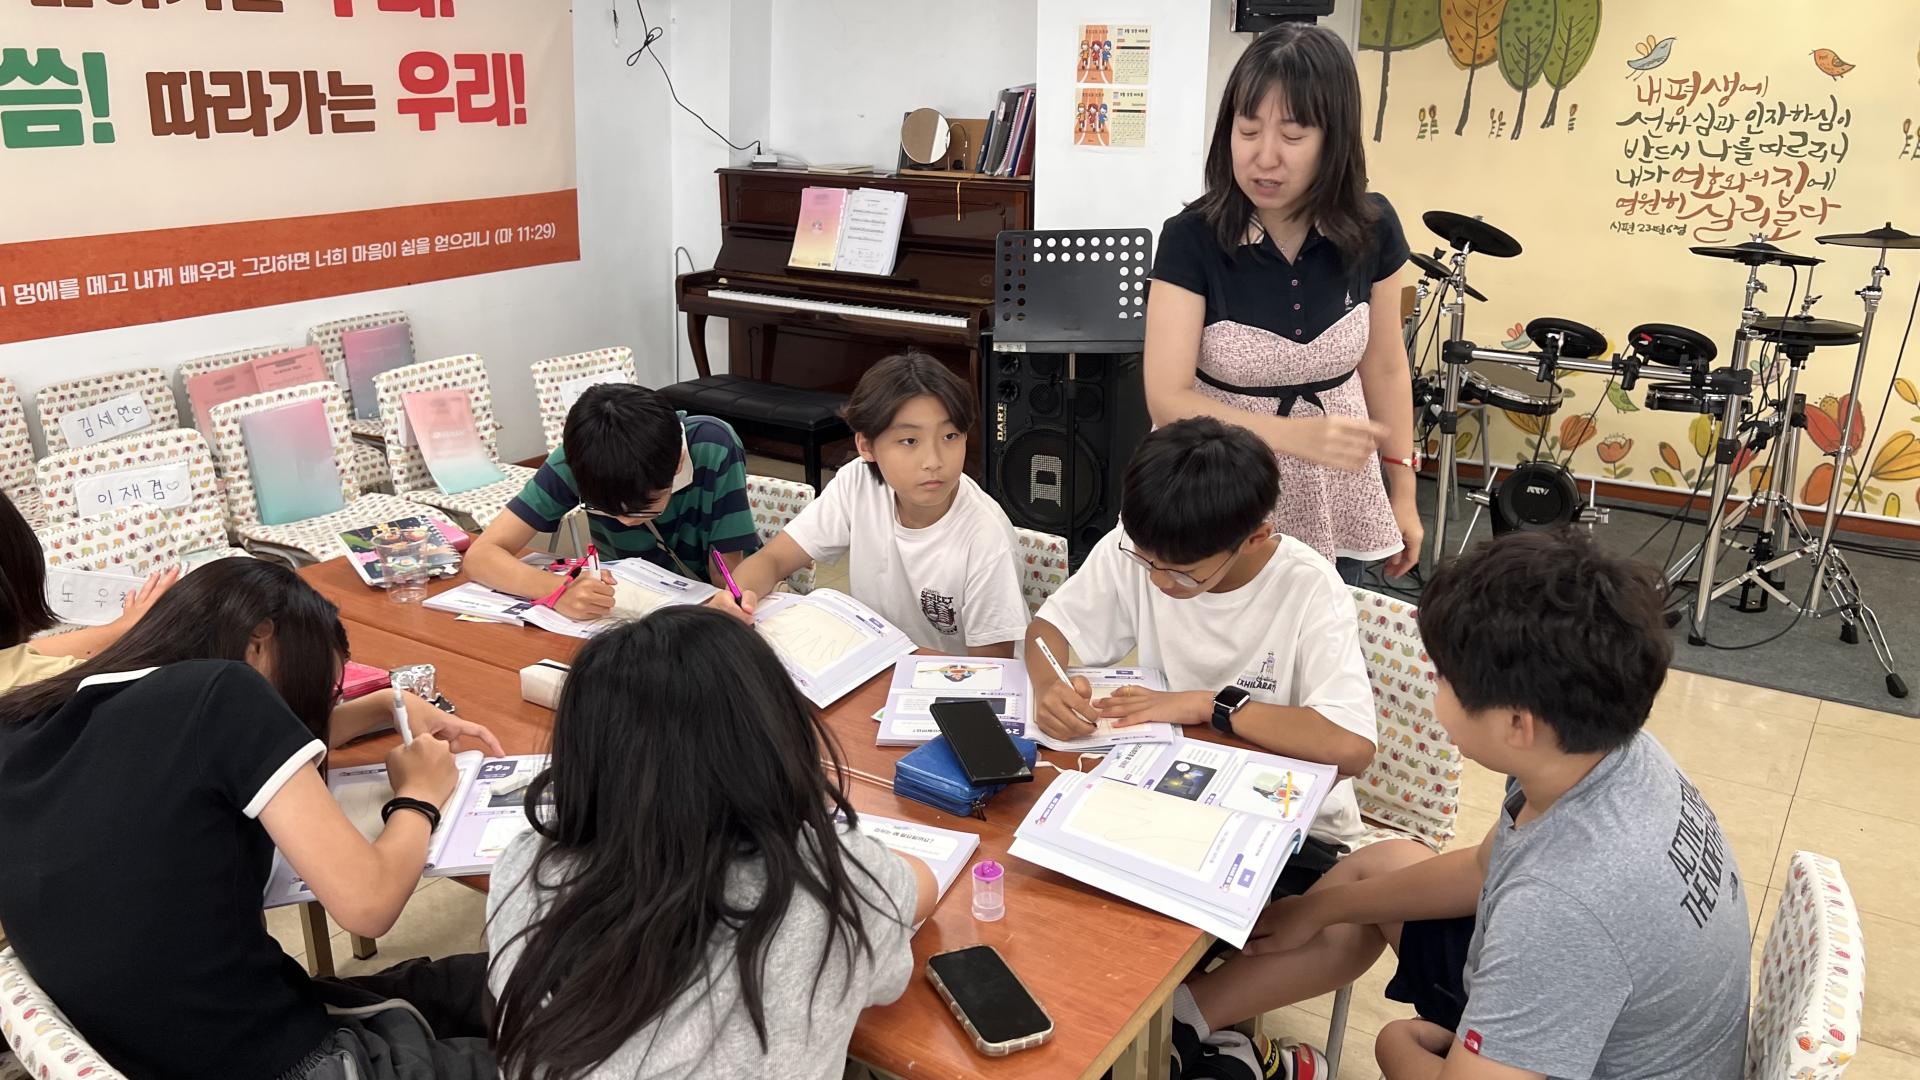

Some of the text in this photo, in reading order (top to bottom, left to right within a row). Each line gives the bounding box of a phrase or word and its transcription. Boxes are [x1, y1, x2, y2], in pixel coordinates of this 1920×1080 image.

[145, 70, 377, 139] 따라가는
[397, 51, 528, 131] 우리!
[1616, 95, 1851, 138] 선하심과 인자하심이
[1625, 131, 1849, 165] 반드시 나를 따르리니
[1616, 165, 1670, 188] 내가
[1672, 163, 1769, 199] 여호와의
[1610, 221, 1635, 235] 시편
[1616, 189, 1842, 243] 영원히 살리로다
[13, 278, 80, 305] 멍에를
[86, 272, 128, 296] 메고
[134, 268, 174, 290] 내게
[179, 260, 236, 284] 배우라
[241, 252, 310, 277] 그리하면
[315, 247, 347, 268] 너희
[352, 241, 397, 263] 마음이
[400, 236, 431, 257] 쉼을
[435, 229, 490, 251] 얻으리니
[494, 227, 513, 247] (마
[518, 222, 556, 243] 11:29)
[77, 405, 134, 437] 김세연
[996, 402, 1005, 441] DART
[97, 479, 165, 505] 이재겸
[1667, 805, 1704, 886] ACTIVE
[1680, 873, 1717, 929] THE
